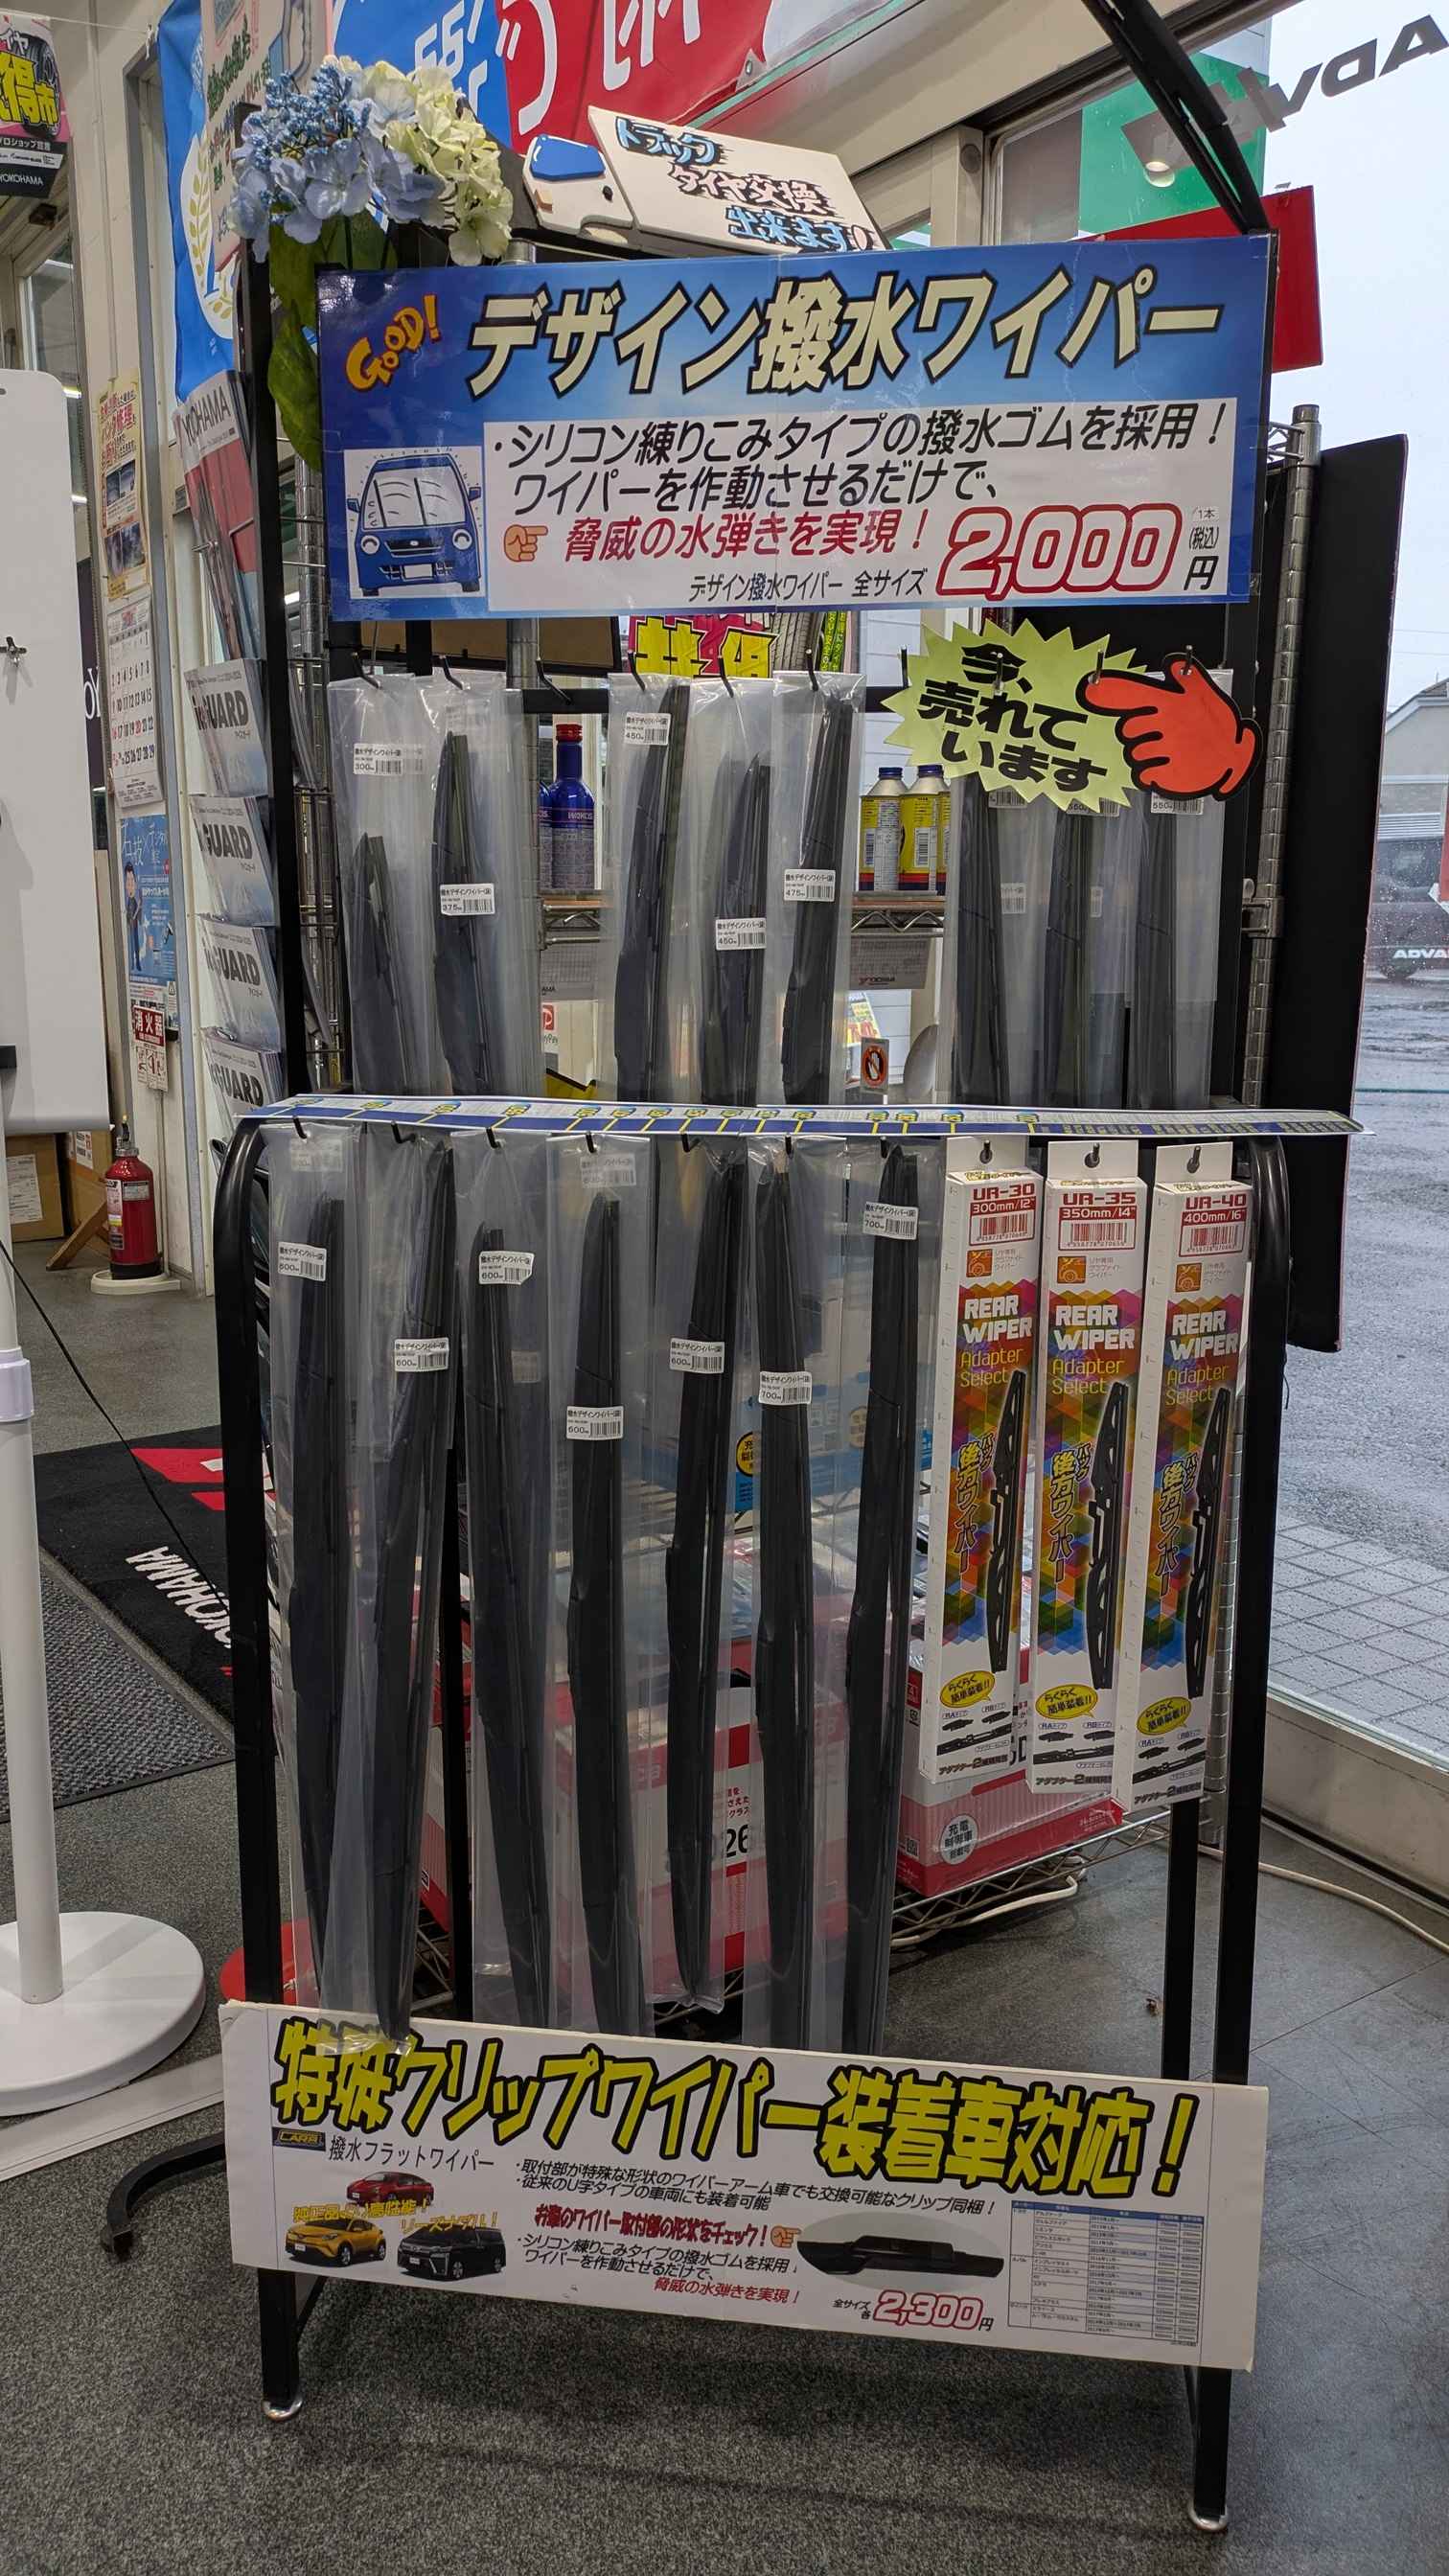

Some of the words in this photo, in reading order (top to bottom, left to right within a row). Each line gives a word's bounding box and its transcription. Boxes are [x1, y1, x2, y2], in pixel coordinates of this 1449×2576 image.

[615, 116, 723, 167] トラック
[669, 162, 835, 217] タイヤ交換
[346, 293, 442, 392] GOOD!
[465, 262, 1225, 401] デザイン撥水ワイパー
[514, 459, 998, 516] ワイパーを作動させるだけで、
[564, 508, 930, 564] 脅威の水弾きを実現！
[1188, 525, 1220, 550] (税込)
[935, 502, 1184, 602] 2,000
[688, 568, 843, 604] デザイン撥水ワイパー
[853, 567, 929, 599] 全サイズ
[1184, 556, 1220, 591] 円
[917, 678, 1089, 752] 売れて
[941, 730, 1108, 793] います
[1392, 948, 1449, 959] ADVA
[134, 1010, 164, 1038] 消火器
[973, 1182, 1036, 1201] UR-30
[1063, 1191, 1137, 1206] UR-35
[1185, 1193, 1247, 1209] UR-40
[964, 1294, 1020, 1321] REAR
[1055, 1303, 1119, 1327] REAR
[962, 1316, 1033, 1346] WIPER
[1172, 1309, 1228, 1337] REAR
[1053, 1328, 1137, 1352] WIPER
[1170, 1332, 1239, 1362] WIPER
[960, 1347, 1024, 1368] Adapter
[1052, 1357, 1125, 1377] Adapter
[960, 1368, 1008, 1389] Select
[1051, 1379, 1107, 1396] Select
[1165, 1363, 1230, 1385] Adapter
[1165, 1383, 1213, 1407] Select
[1075, 1442, 1091, 1482] バック
[954, 1440, 981, 1575] 後方ワイパー
[1048, 1449, 1075, 1583] 後方ワイパー
[1155, 1461, 1184, 1597] 後方ワイパー
[272, 2014, 1200, 2198] 特殊クリップワイパー装着車対応！
[329, 2135, 494, 2172] 撥水フラットワイパー
[525, 2249, 714, 2281] ワイパーを作動させるだけで、
[655, 2277, 800, 2304] 脅威の水弾きを実現！
[833, 2298, 870, 2311] 全サイズ
[873, 2289, 983, 2331] 2,300
[979, 2317, 995, 2332] 円
